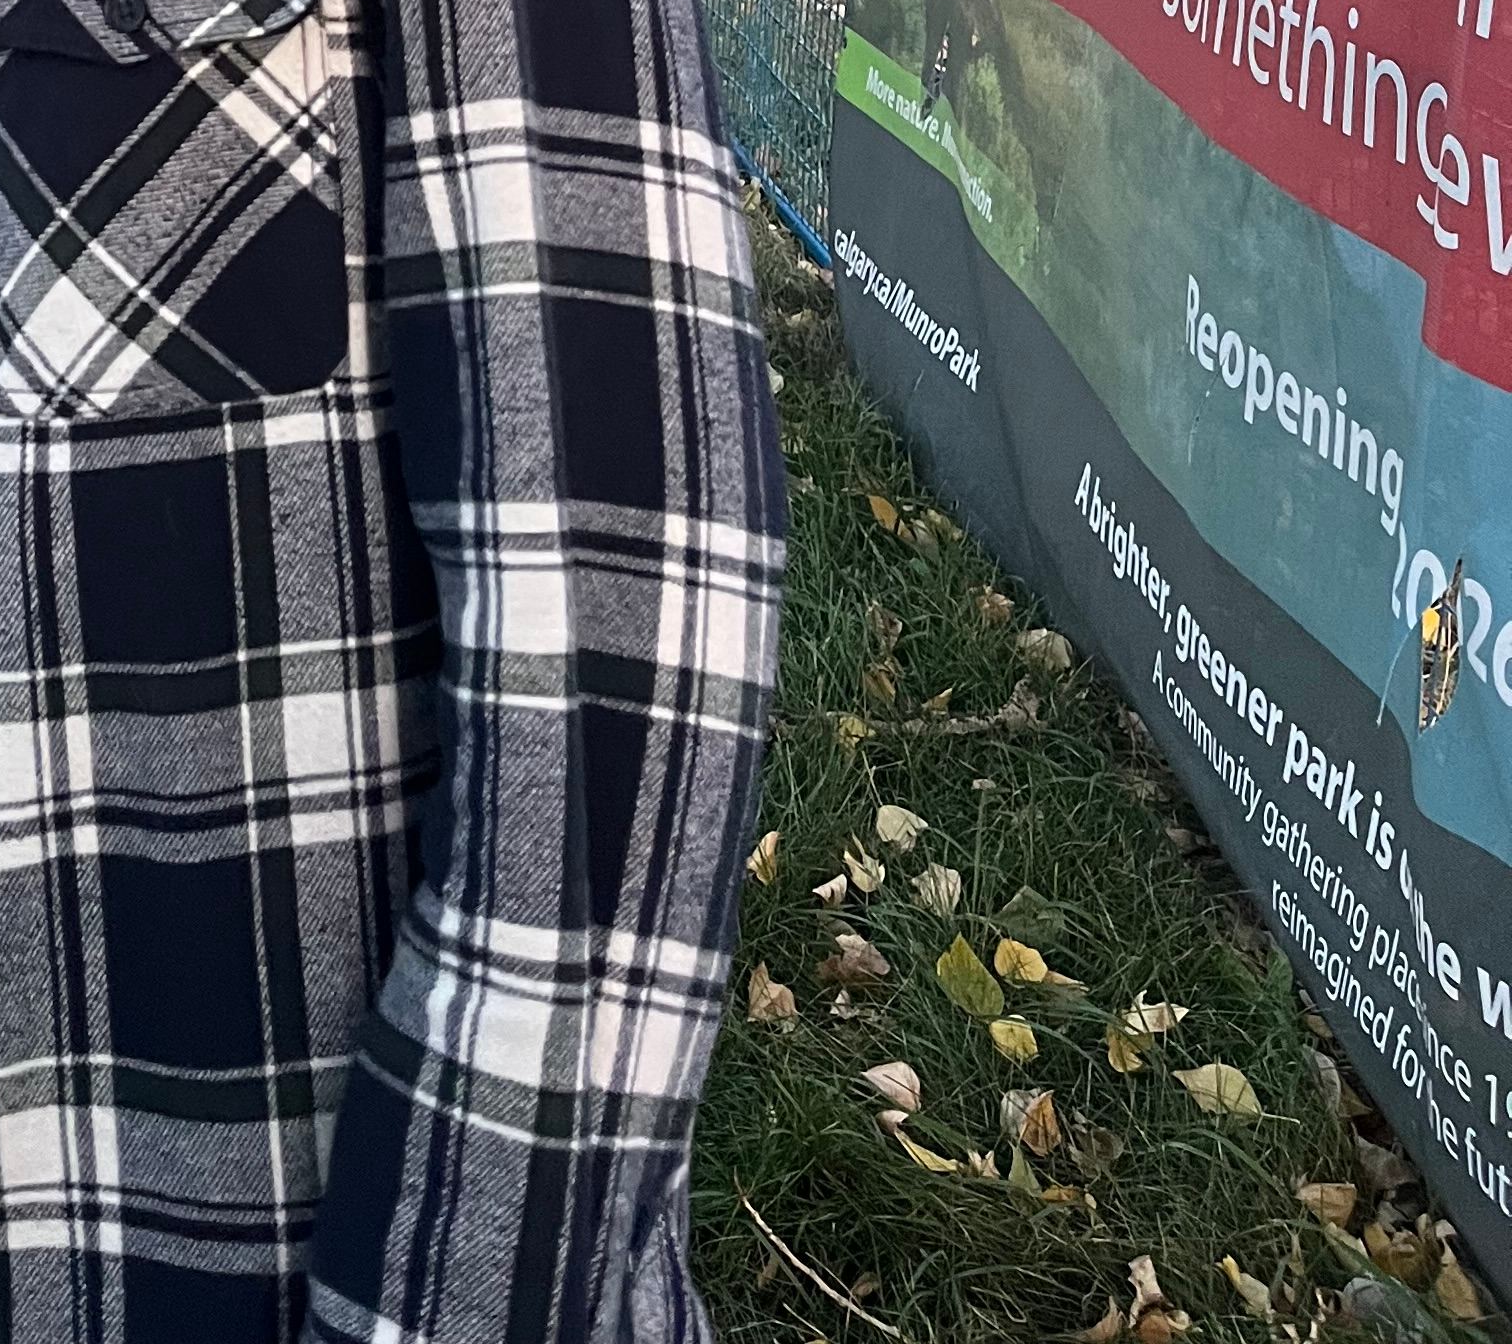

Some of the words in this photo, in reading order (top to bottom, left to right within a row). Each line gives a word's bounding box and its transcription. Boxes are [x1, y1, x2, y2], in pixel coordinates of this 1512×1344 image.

[865, 65, 896, 110] More
[833, 228, 981, 393] calgary.ca/MunroPark
[1185, 273, 1405, 537] Reopening
[1074, 462, 1092, 516] A
[1089, 476, 1172, 634] brighter,
[1175, 603, 1284, 748] greener
[1282, 722, 1365, 840] park
[1364, 790, 1396, 870] is
[1152, 649, 1164, 694] A
[1165, 676, 1262, 822] community
[1261, 801, 1370, 953] gathering
[1271, 879, 1394, 1055] reimagined
[1392, 1023, 1427, 1100] for
